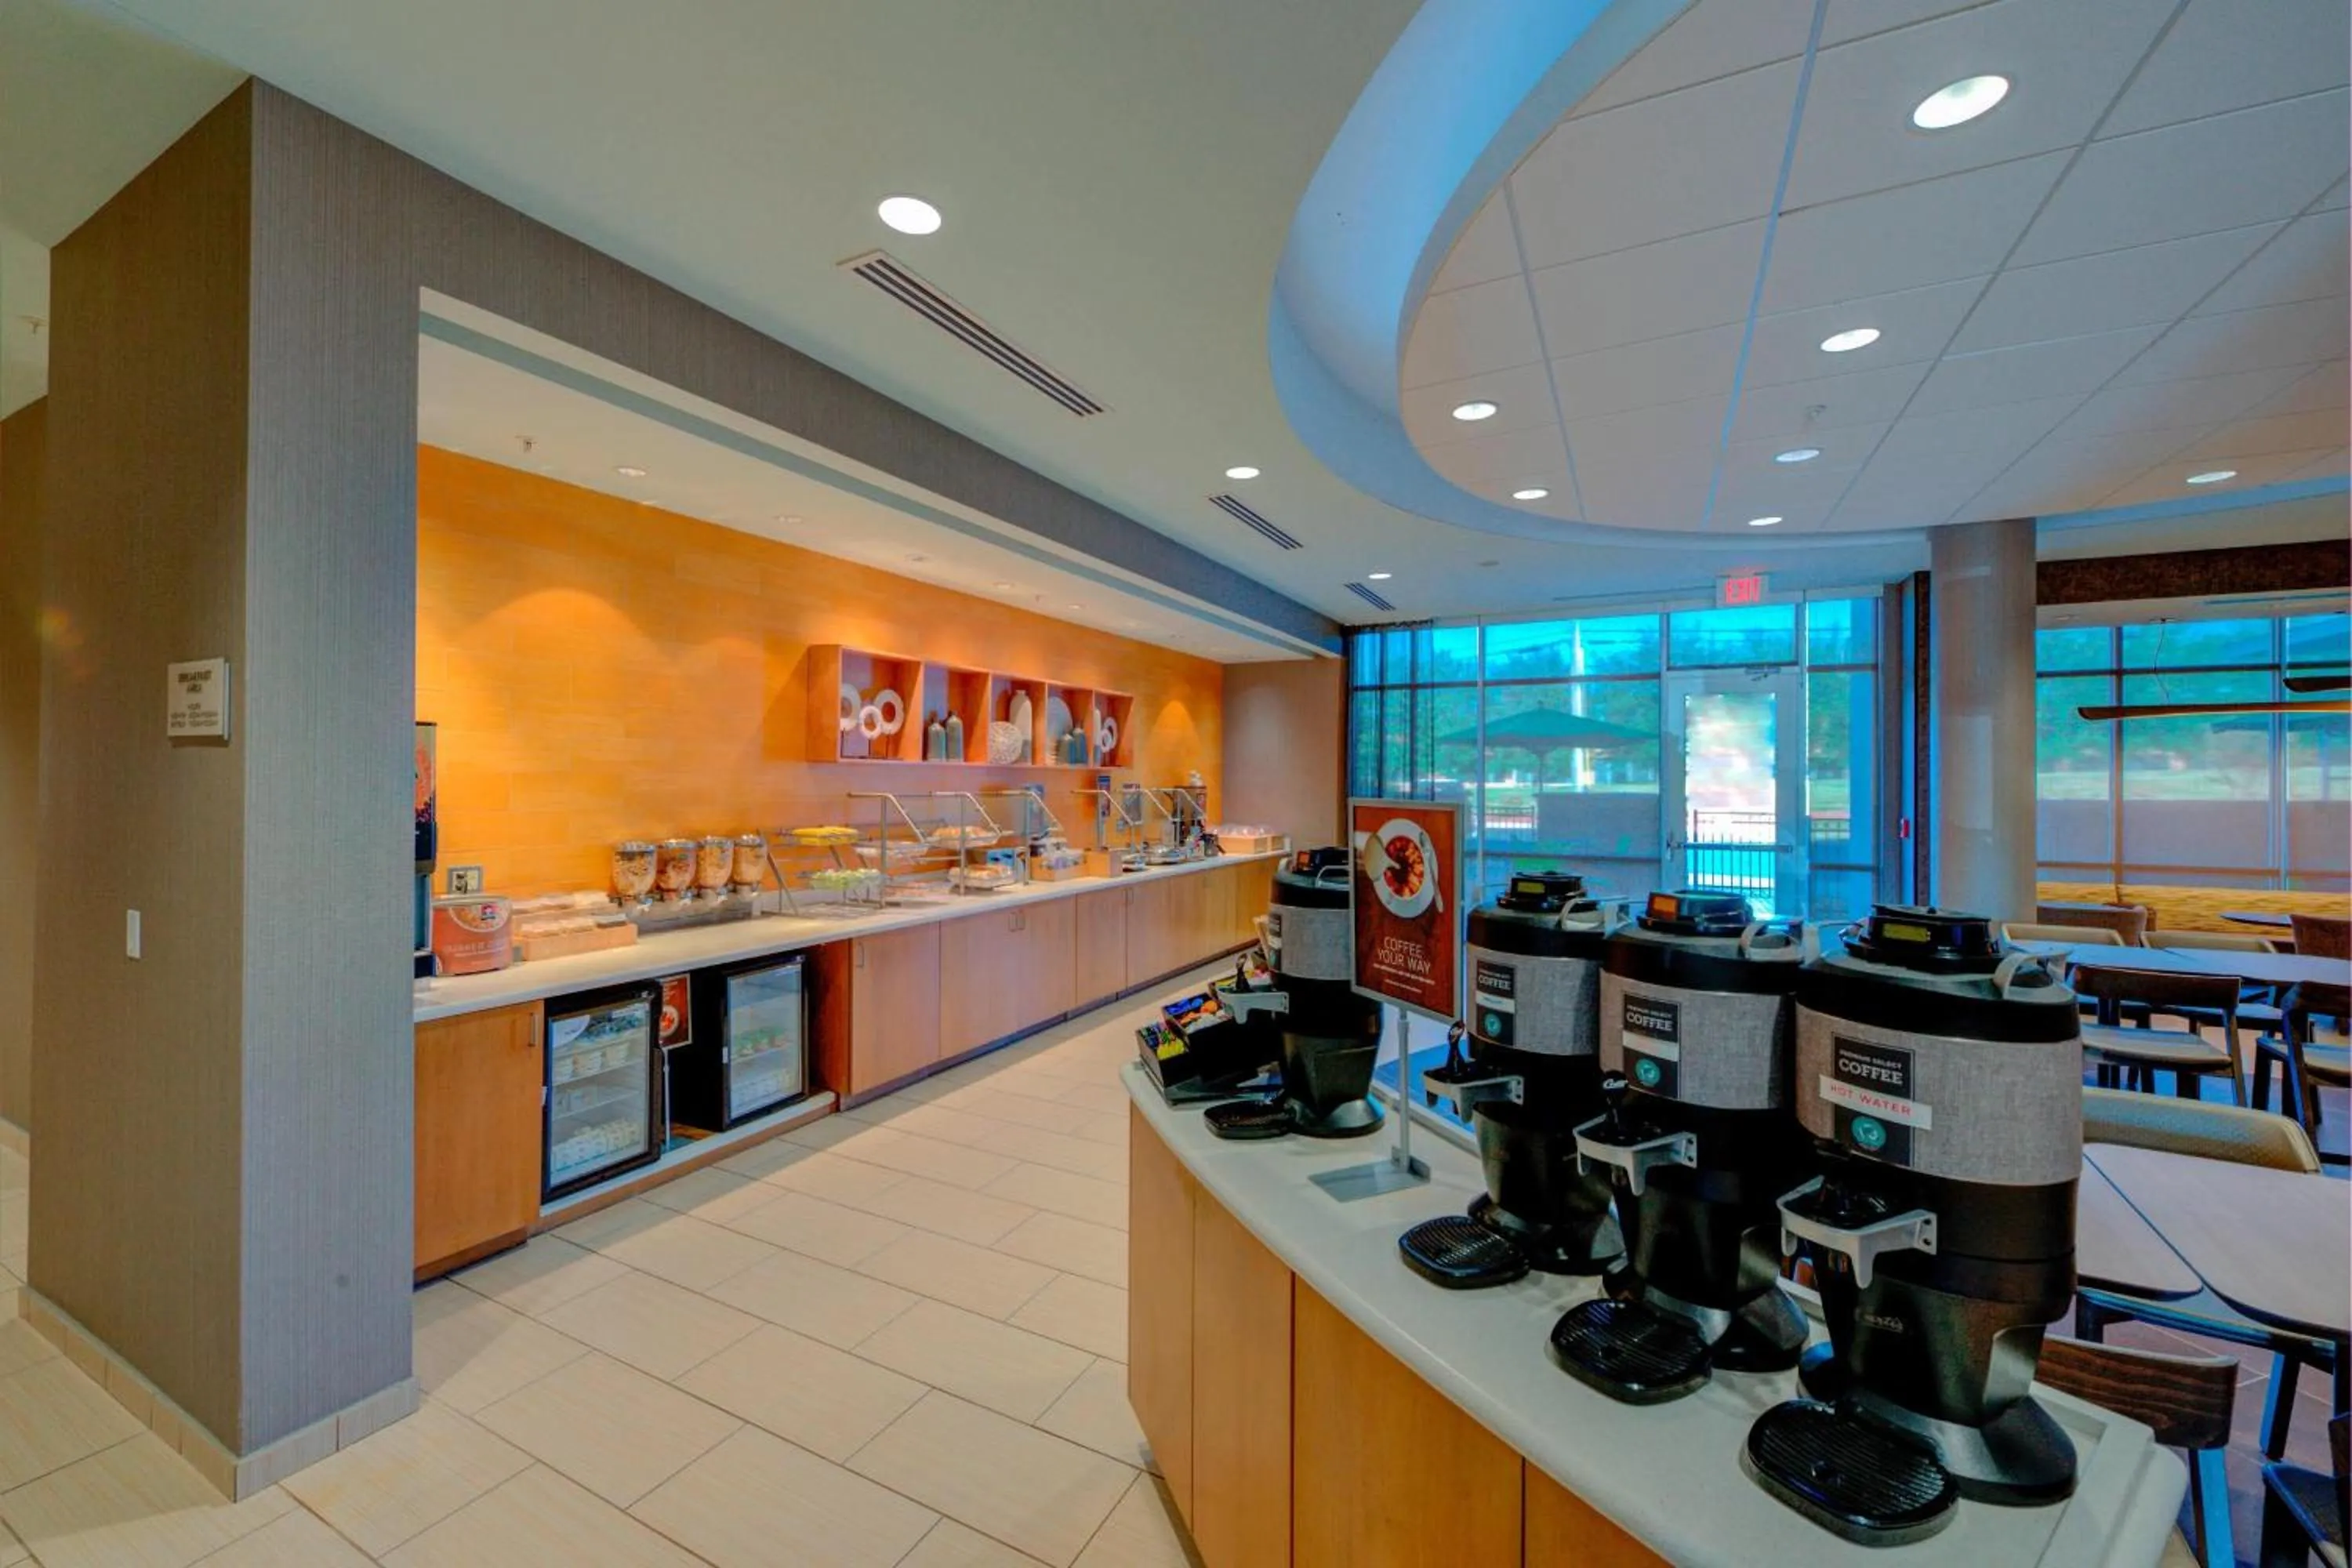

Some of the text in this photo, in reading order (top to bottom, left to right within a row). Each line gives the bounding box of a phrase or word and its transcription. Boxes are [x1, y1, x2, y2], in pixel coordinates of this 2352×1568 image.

[1725, 576, 1761, 604] EXIT
[1384, 936, 1423, 958] COFFEE
[1377, 947, 1405, 967] YOUR
[1407, 956, 1431, 975] WAY
[1478, 975, 1512, 990] COFFEE
[1626, 1011, 1673, 1031] COFFEE
[1838, 1058, 1904, 1085] COFFEE
[1831, 1084, 1912, 1116] HOT WATER
